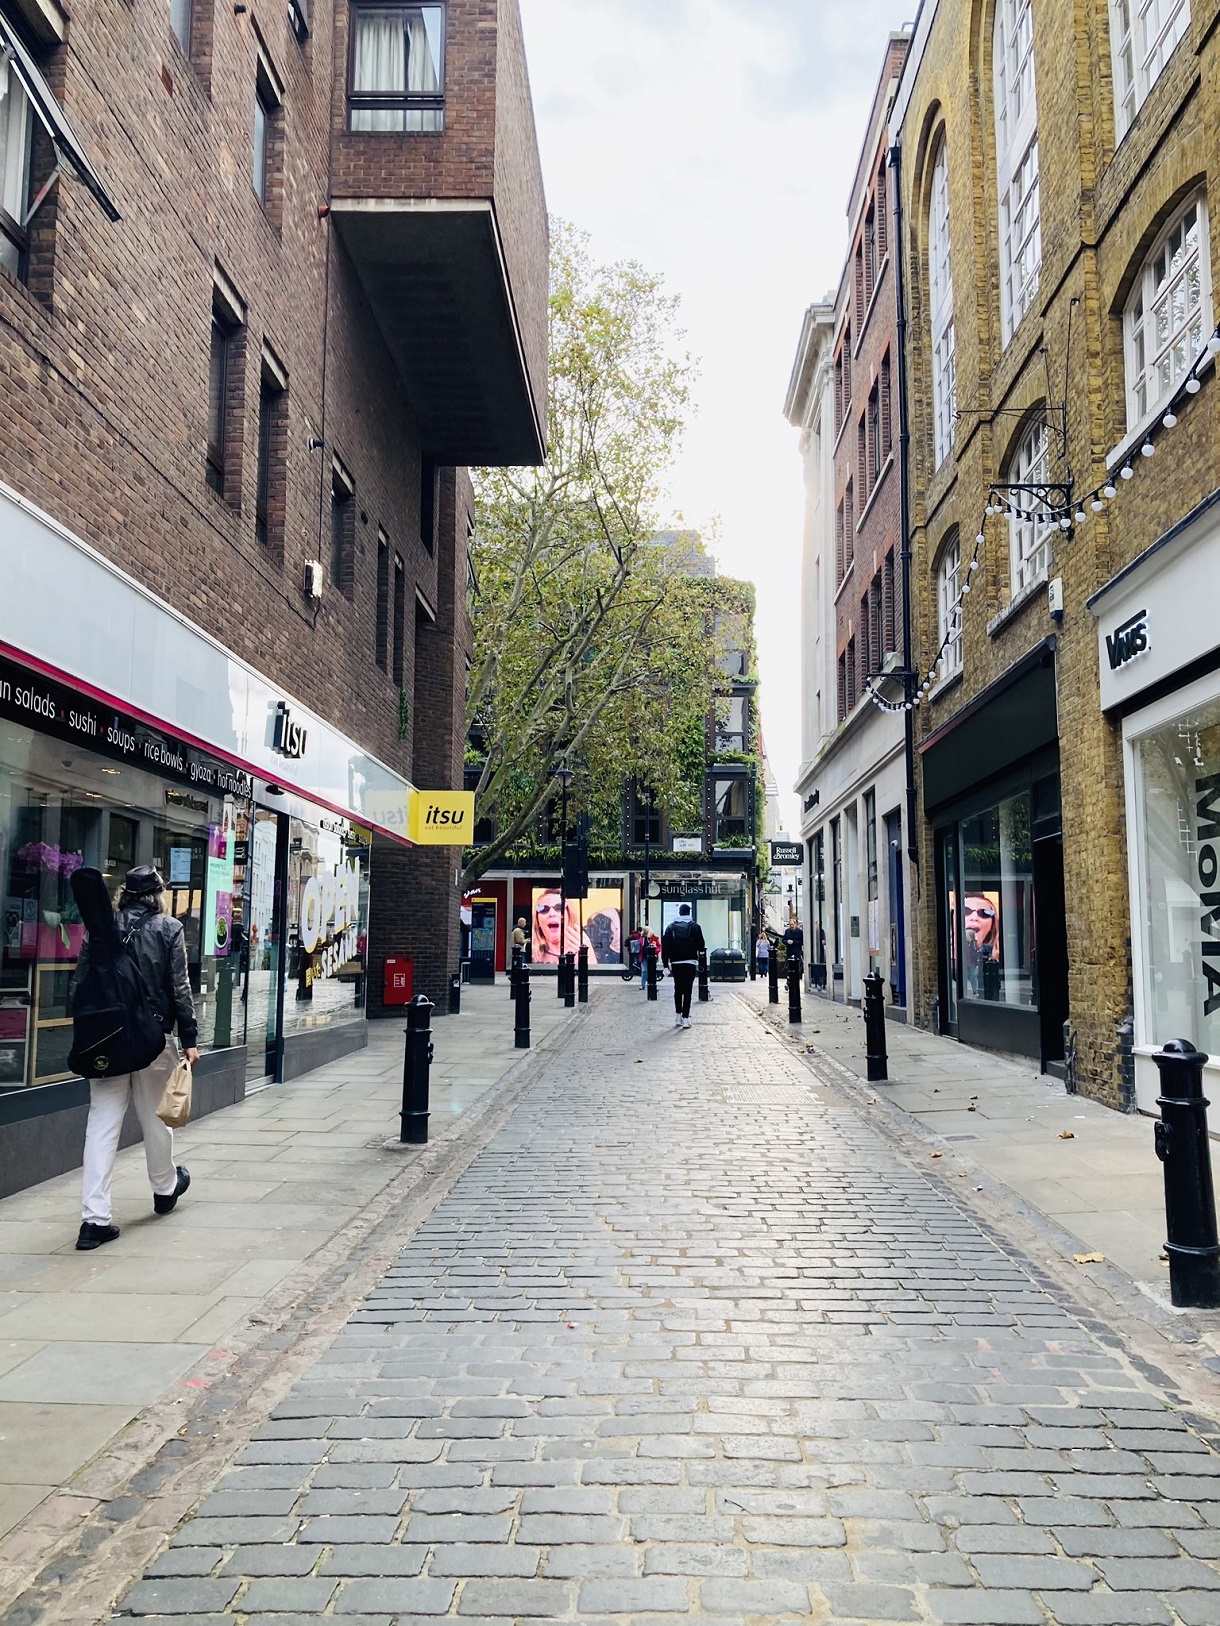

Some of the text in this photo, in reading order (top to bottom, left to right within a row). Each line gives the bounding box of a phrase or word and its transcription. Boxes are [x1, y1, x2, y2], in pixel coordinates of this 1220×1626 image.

[1105, 609, 1147, 670] VANS
[14, 686, 56, 719] salads
[69, 709, 97, 736] sushi
[106, 726, 135, 754] soups
[143, 741, 160, 762] rice
[160, 750, 184, 771] bowls
[190, 762, 212, 782] gyoza
[228, 778, 252, 798] noodles
[271, 700, 308, 758] itsu
[425, 804, 465, 825] itsu
[775, 846, 797, 854] Russell
[302, 855, 360, 954] OPEN
[661, 883, 722, 897] sunglass hut
